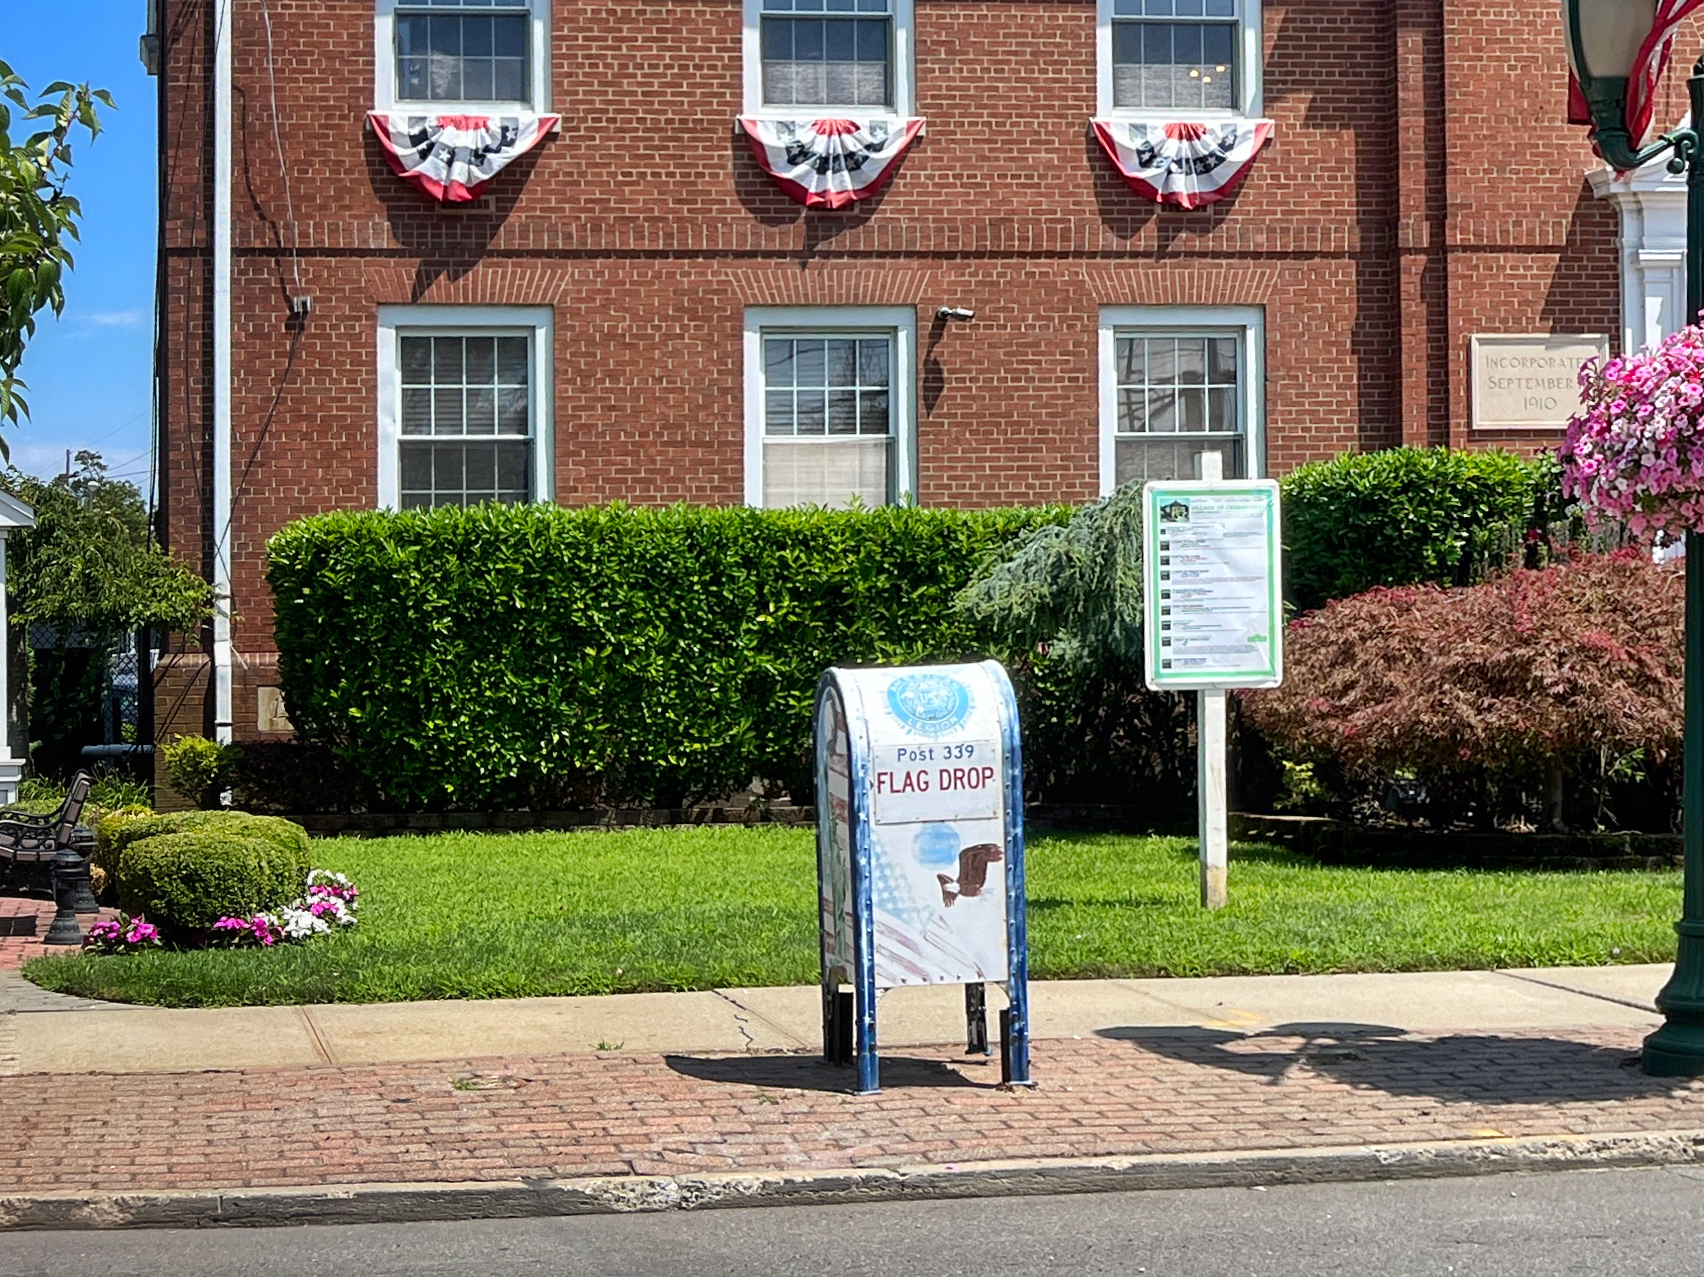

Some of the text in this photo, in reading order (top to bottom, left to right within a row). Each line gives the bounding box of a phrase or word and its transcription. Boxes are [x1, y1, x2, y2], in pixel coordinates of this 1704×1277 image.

[1485, 356, 1588, 370] INCORPORATE
[1487, 376, 1574, 390] SEPTEMBER
[1523, 396, 1558, 411] 1910
[907, 716, 959, 732] LEGION
[897, 744, 974, 762] Post 339
[877, 766, 994, 794] FLAG DROP
